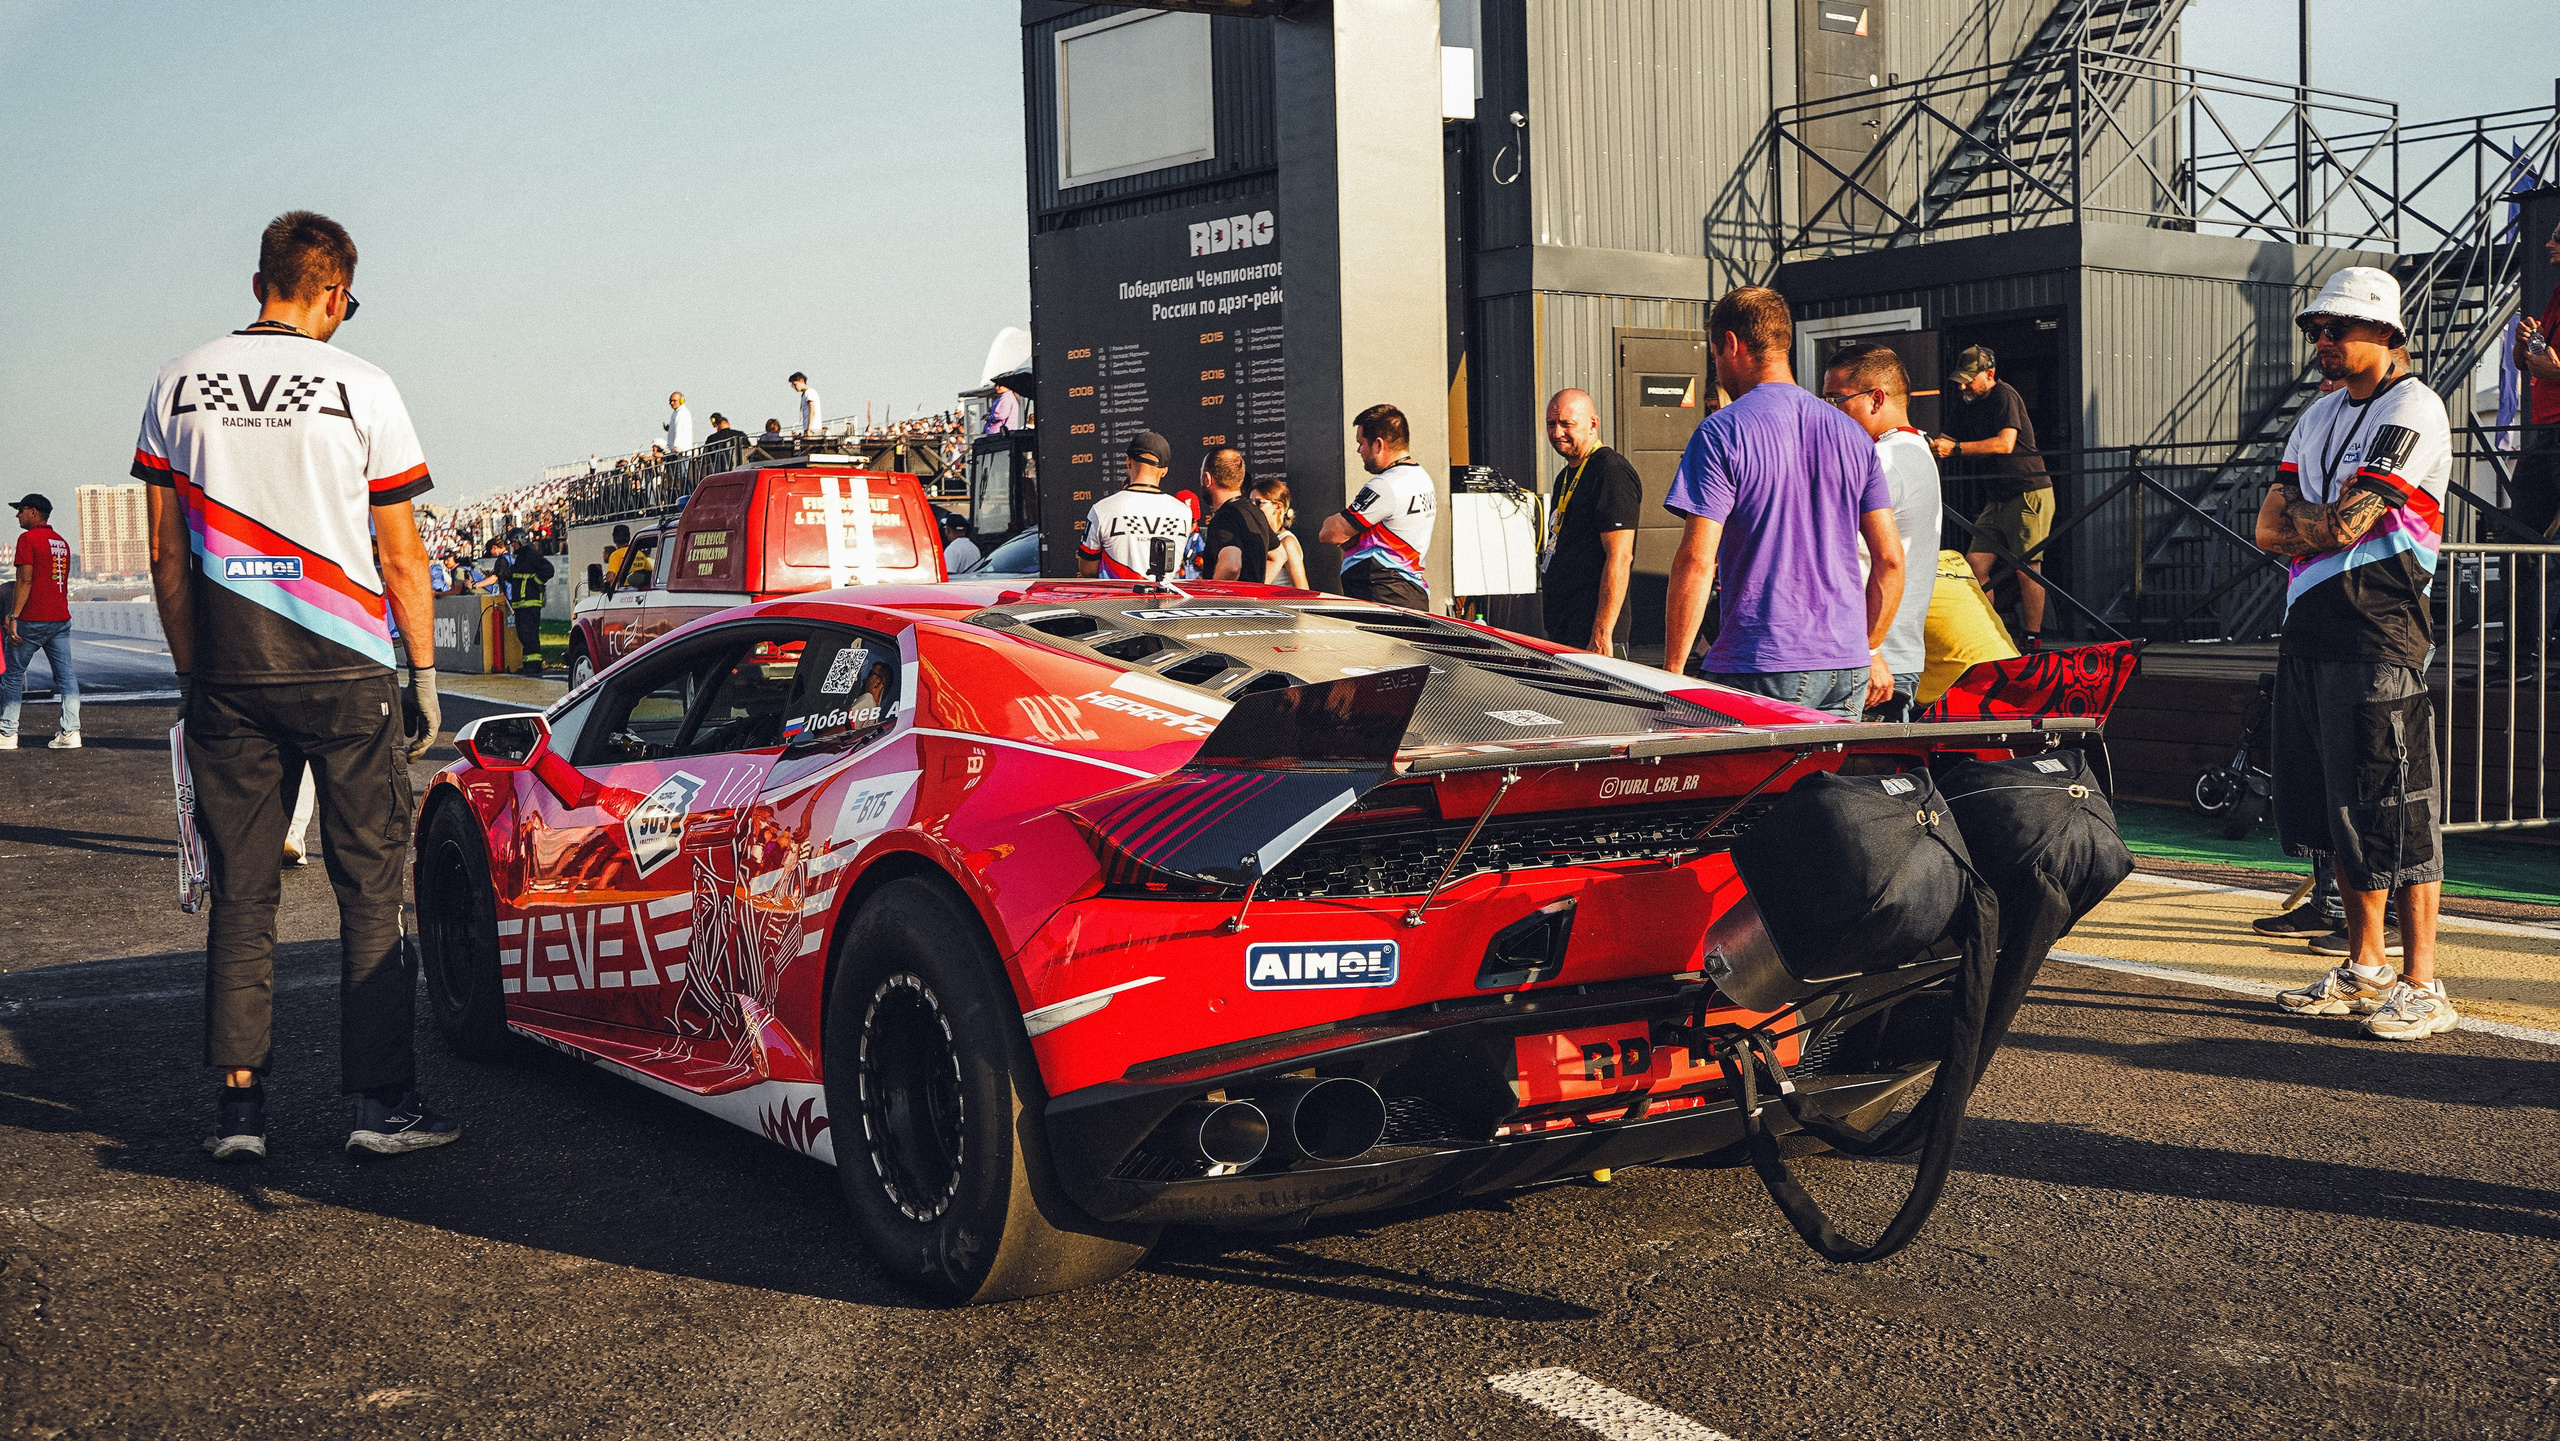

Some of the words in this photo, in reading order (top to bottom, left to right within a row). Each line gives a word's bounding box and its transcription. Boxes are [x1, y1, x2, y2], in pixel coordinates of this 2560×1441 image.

[1188, 210, 1274, 257] RDRC
[1119, 276, 1194, 300] Победители
[1152, 303, 1197, 321] России
[1199, 299, 1216, 315] по
[1200, 331, 1224, 344] 2015
[1067, 348, 1091, 360] 2005
[1201, 368, 1226, 381] 2016
[1068, 385, 1094, 397] 2008
[1201, 395, 1225, 406] 2017
[222, 416, 262, 427] RACING
[266, 417, 292, 428] TEAM
[1070, 423, 1096, 434] 2009
[1202, 434, 1226, 446] 2018
[1071, 453, 1093, 464] 2010
[1073, 490, 1092, 501] 2011
[706, 532, 727, 545] RESCUE
[698, 563, 714, 576] TEAM
[609, 630, 622, 656] FC
[804, 706, 880, 733] Лобачев
[1618, 774, 1700, 796] YURA_CBR_RR
[857, 791, 893, 824] ВТБ
[1252, 951, 1391, 980] AIMOL
